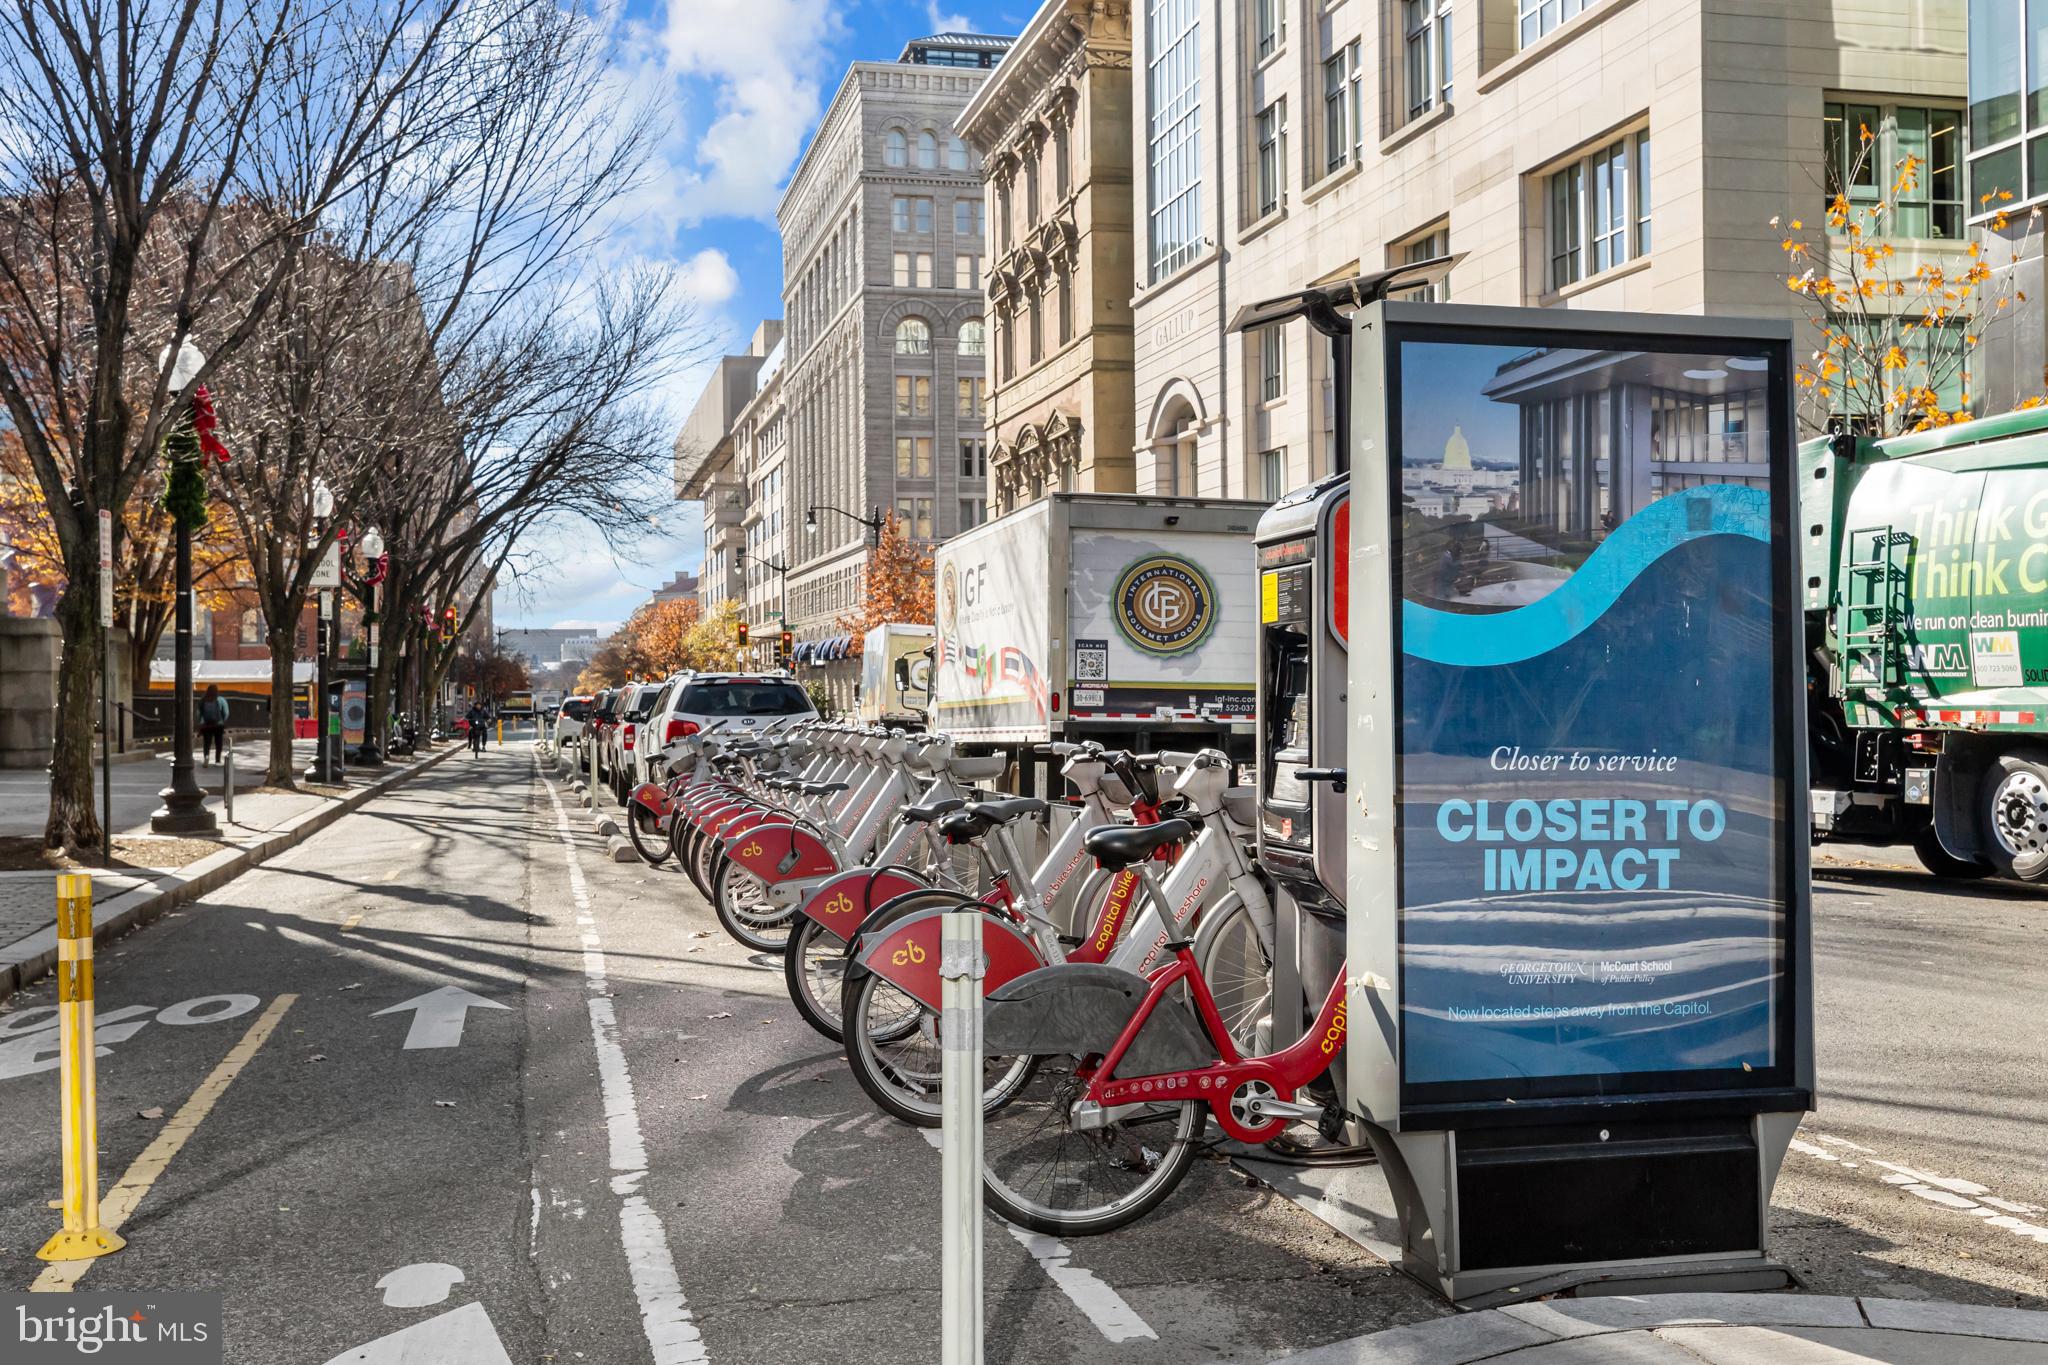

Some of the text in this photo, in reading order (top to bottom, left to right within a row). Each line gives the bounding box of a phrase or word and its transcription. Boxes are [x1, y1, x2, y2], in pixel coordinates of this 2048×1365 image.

[1156, 309, 1194, 347] GALLUP
[1910, 497, 2017, 548] Think
[313, 570, 330, 578] ONE
[959, 562, 987, 609] IGF
[1128, 568, 1200, 598] INTERNATIONAL
[1904, 544, 2009, 599] Think
[1127, 610, 1201, 641] GOURMET FOODS
[1903, 614, 1921, 631] We
[1925, 616, 1946, 630] run
[1949, 615, 1966, 629] on
[1970, 610, 2003, 629] clean
[1975, 636, 2014, 653] WM
[331, 695, 338, 705] P
[1491, 746, 1678, 772] Closer to service
[1436, 799, 1727, 842] CLOSER TO
[1049, 847, 1085, 891] bikeshare
[1484, 847, 1681, 891] IMPACT
[1096, 870, 1134, 951] capital bike
[1138, 877, 1208, 974] capital keshare
[1500, 961, 1589, 977] GEORGETOWN
[1508, 973, 1577, 985] UNIVERSITY
[1600, 960, 1673, 972] McCourt School
[1600, 974, 1655, 985] of Public Policy
[1448, 1001, 1712, 1020] Now located steps away from the Capitol.
